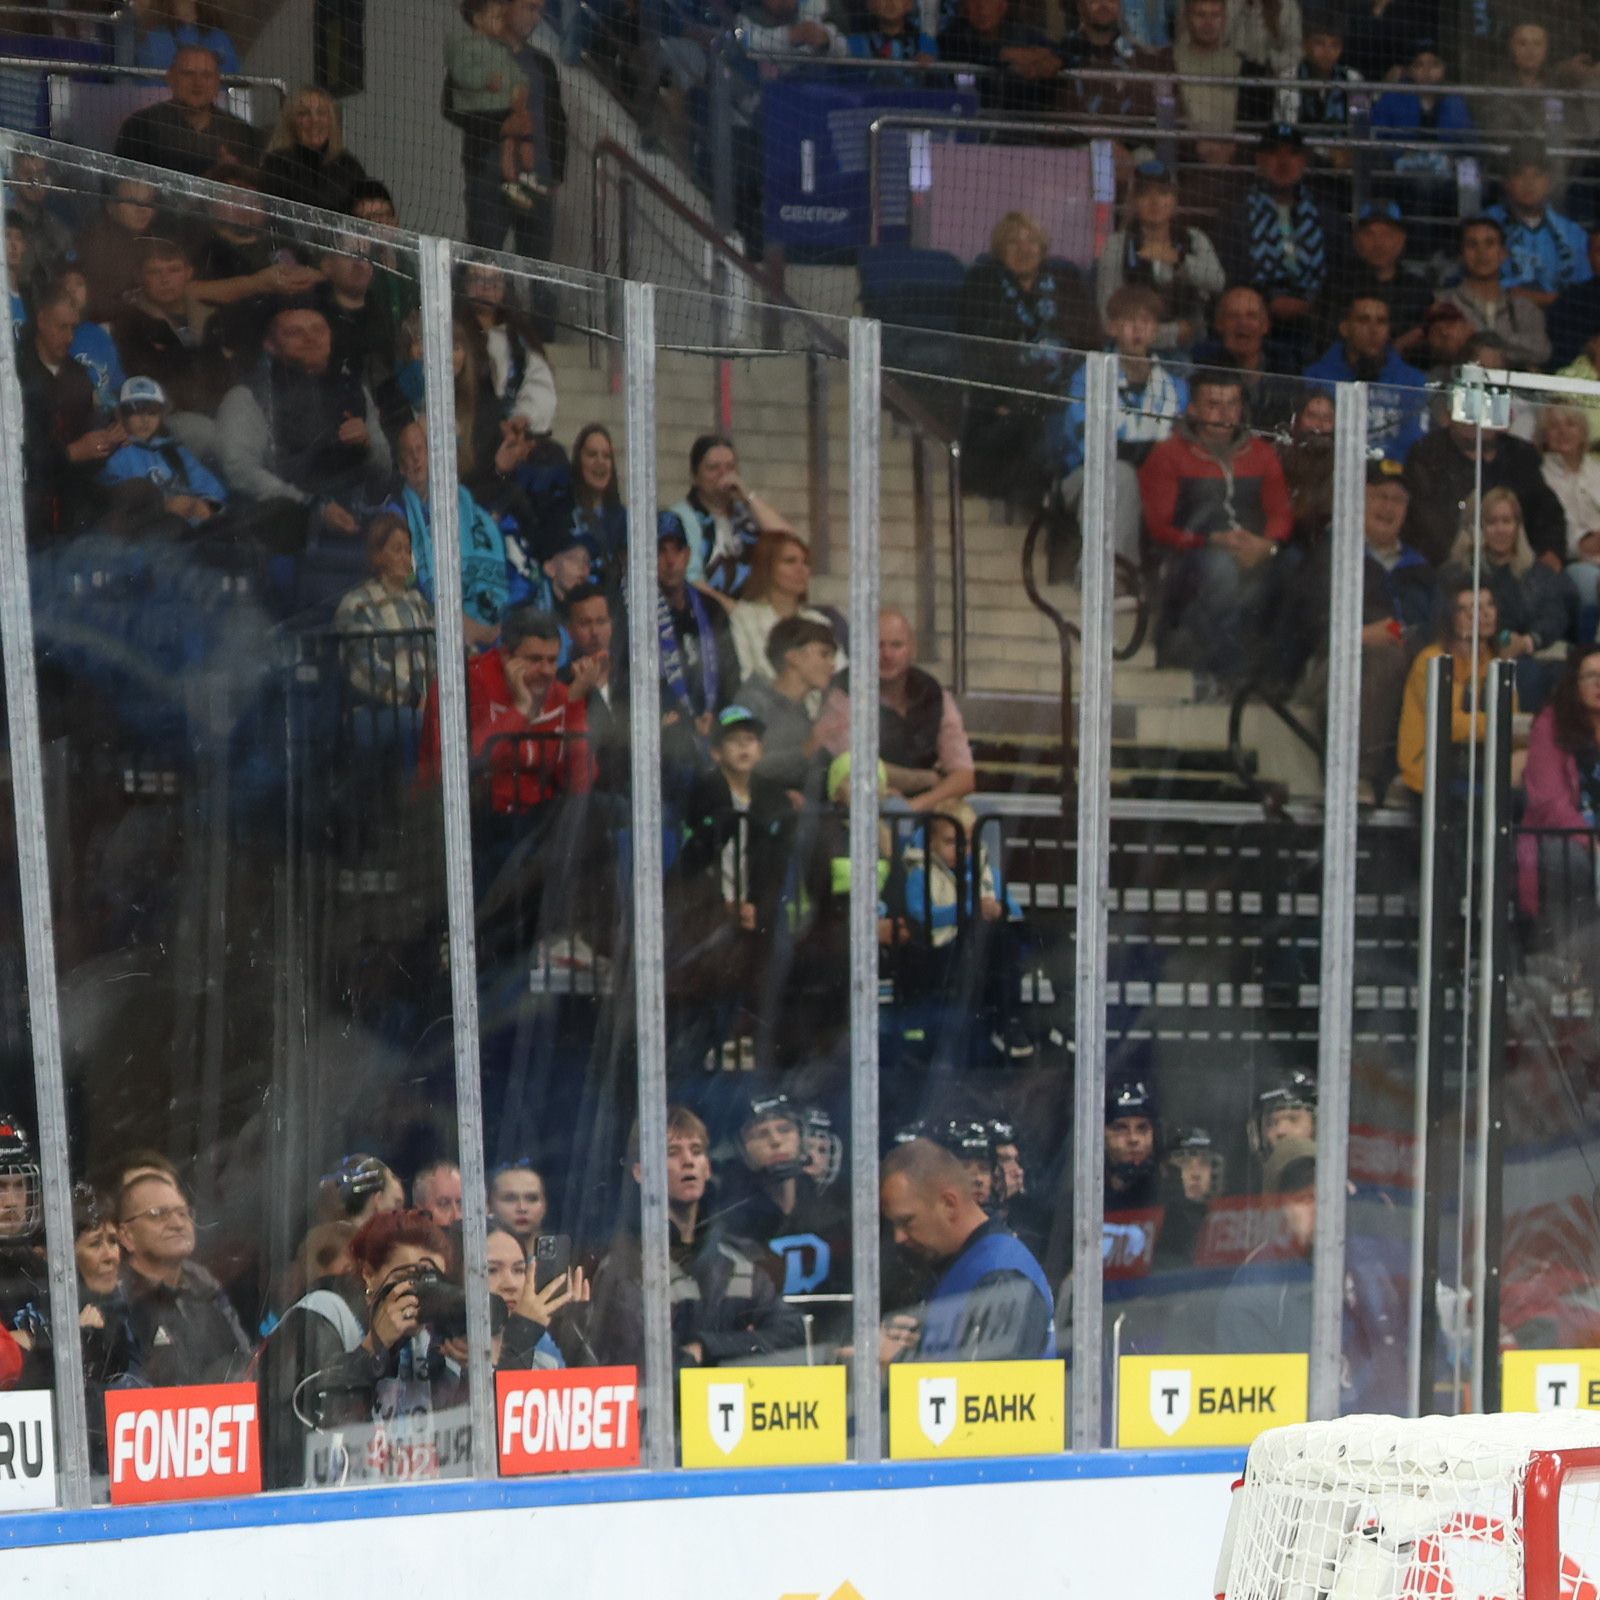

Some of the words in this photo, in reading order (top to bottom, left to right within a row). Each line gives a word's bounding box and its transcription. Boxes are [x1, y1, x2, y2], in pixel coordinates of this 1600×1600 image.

[751, 1400, 820, 1432] БАНК
[963, 1393, 1036, 1424] БАНК
[1198, 1385, 1277, 1415] БАНК
[502, 1385, 635, 1456] FONBET
[113, 1403, 256, 1484] FONBET
